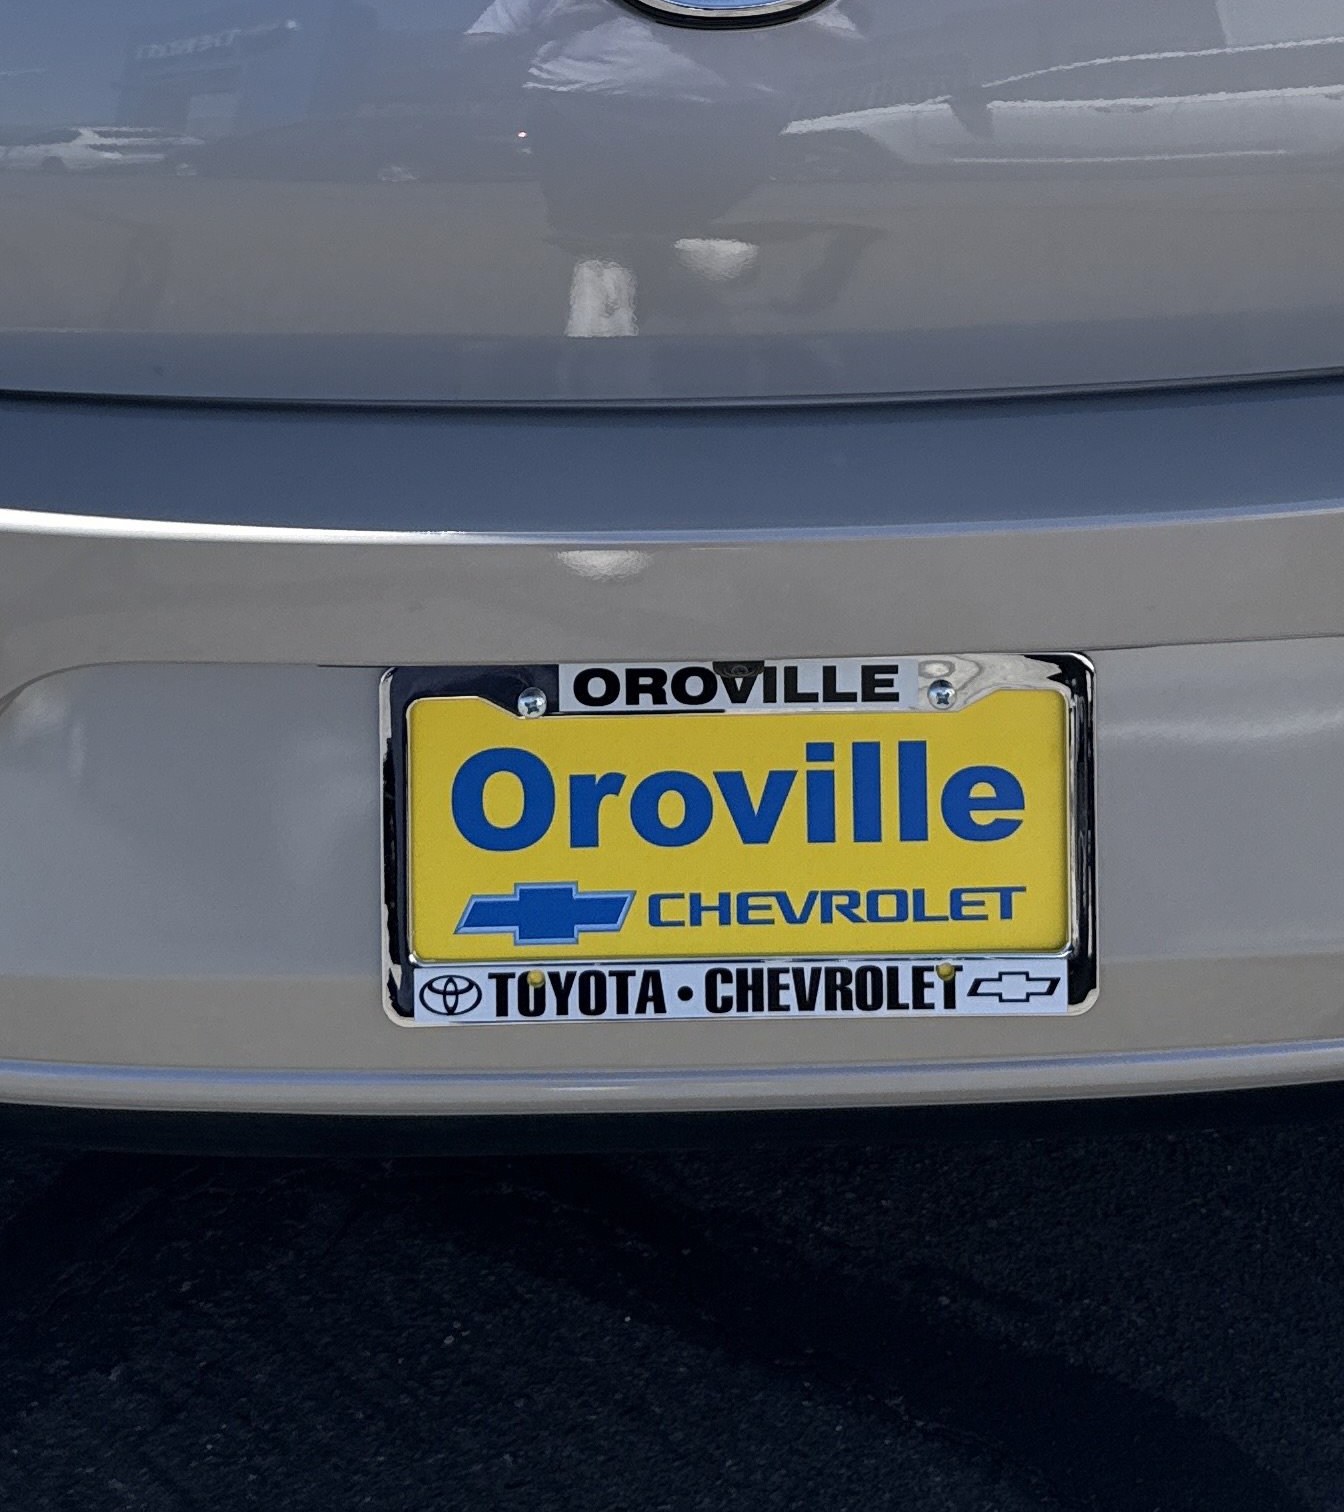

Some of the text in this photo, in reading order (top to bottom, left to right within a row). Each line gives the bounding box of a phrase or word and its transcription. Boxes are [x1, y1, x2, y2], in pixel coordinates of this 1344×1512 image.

[572, 664, 900, 706] OROVILLE
[452, 740, 1025, 852] Oroville
[647, 886, 1027, 928] CHEVROLET
[488, 965, 964, 1018] TOYOTA CHEVROLET
